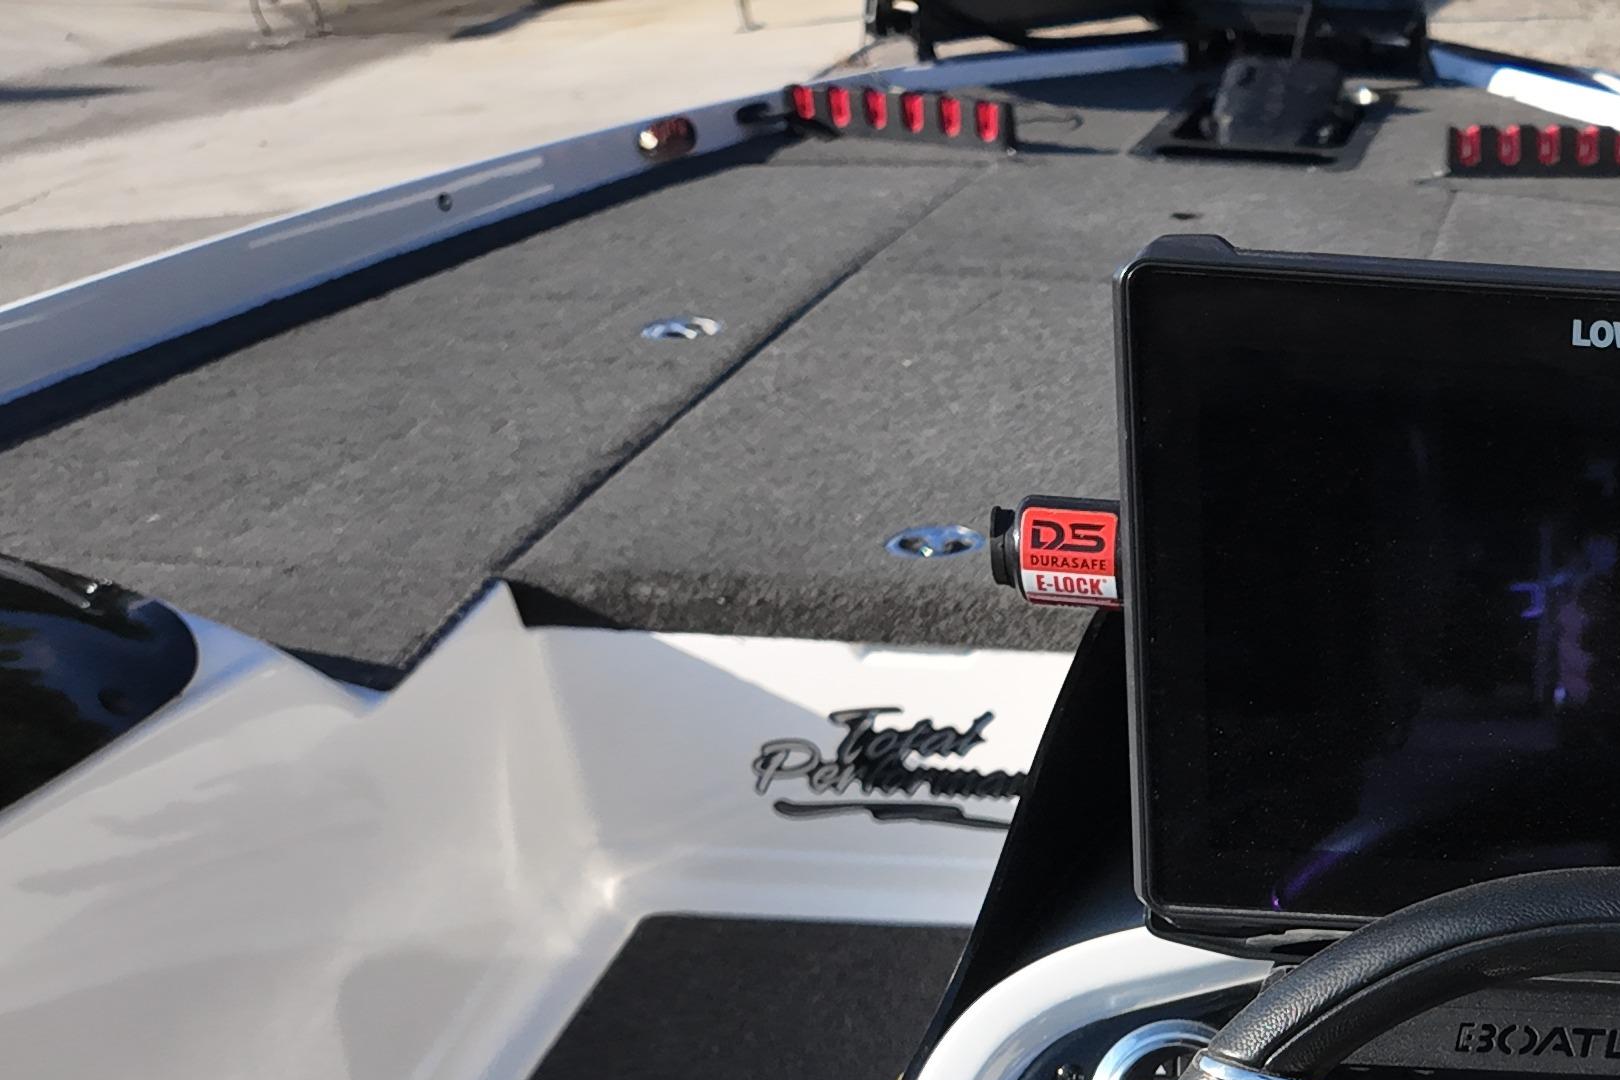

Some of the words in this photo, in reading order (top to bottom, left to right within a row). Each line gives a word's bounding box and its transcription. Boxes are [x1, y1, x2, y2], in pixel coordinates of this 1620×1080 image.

[1031, 519, 1106, 553] DS
[1030, 555, 1107, 571] DURASAFE
[827, 706, 994, 766] Total
